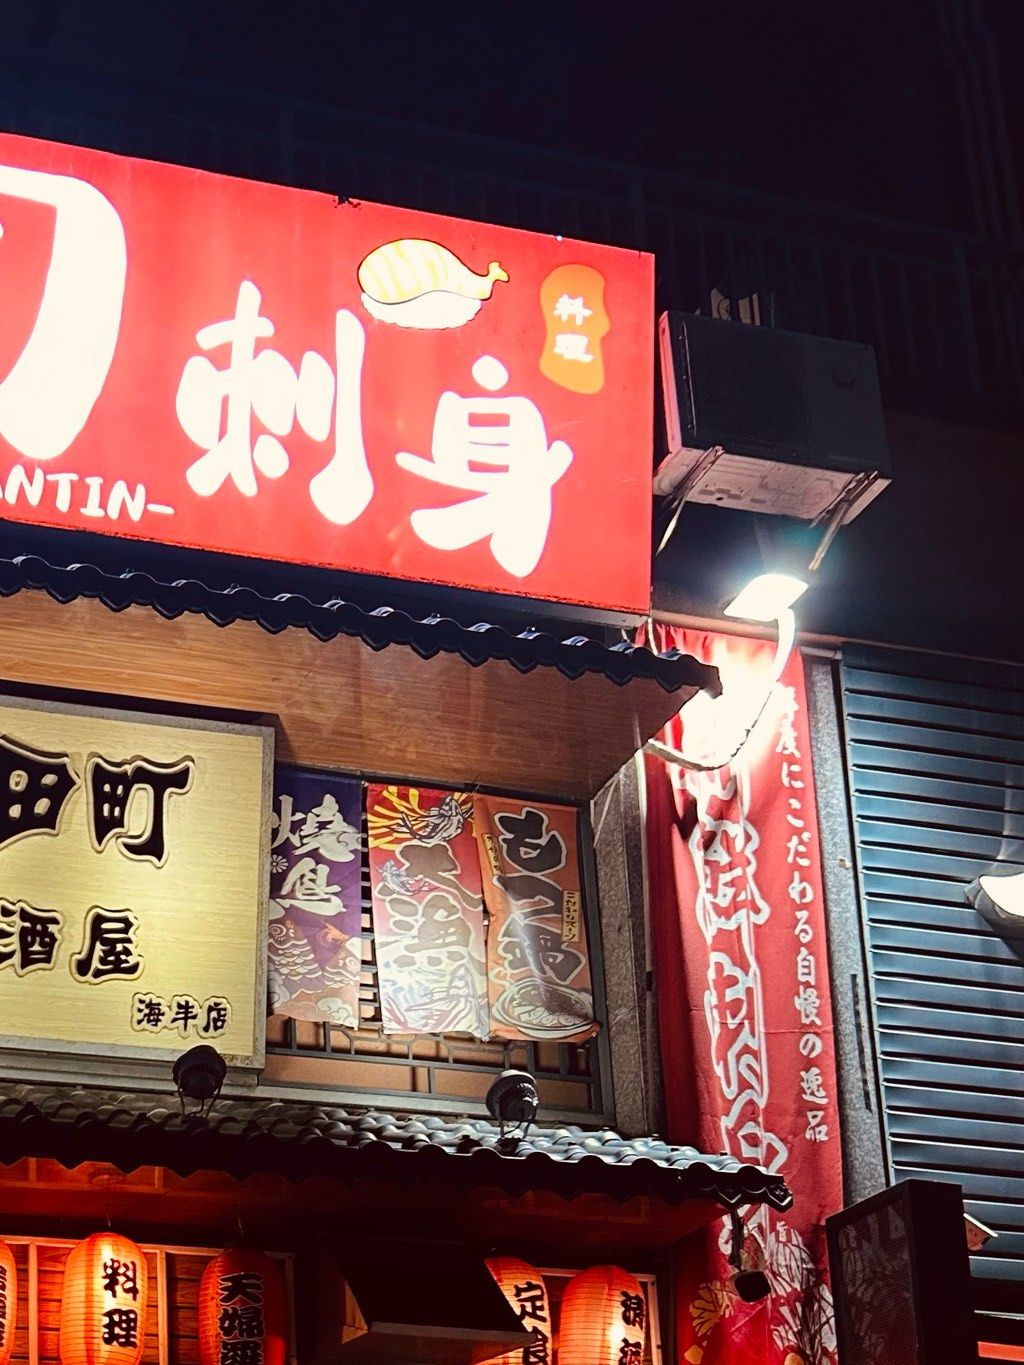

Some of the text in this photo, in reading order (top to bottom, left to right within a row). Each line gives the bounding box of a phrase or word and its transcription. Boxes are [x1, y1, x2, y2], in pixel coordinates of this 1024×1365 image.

[553, 294, 593, 362] 料理
[176, 280, 573, 577] 刺身
[132, 994, 232, 1039] 海牛店
[103, 1258, 139, 1349] 料理
